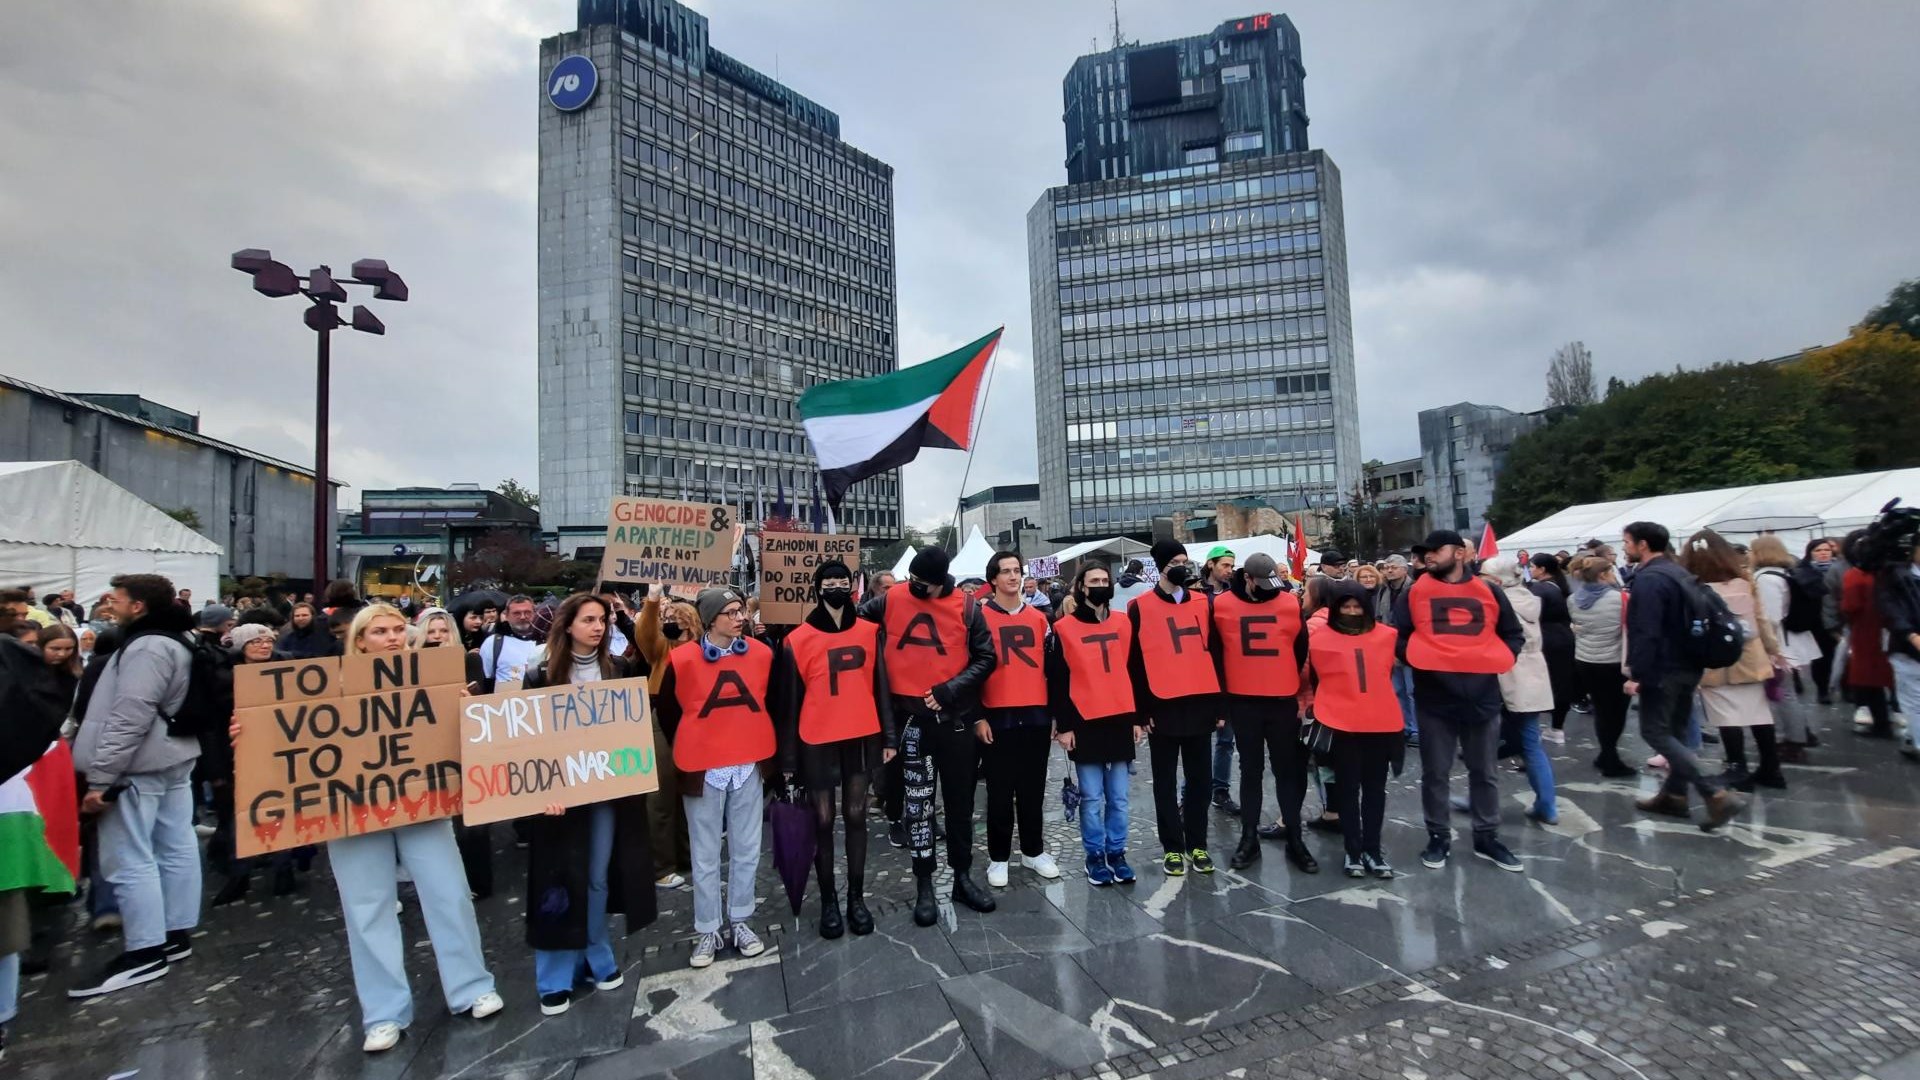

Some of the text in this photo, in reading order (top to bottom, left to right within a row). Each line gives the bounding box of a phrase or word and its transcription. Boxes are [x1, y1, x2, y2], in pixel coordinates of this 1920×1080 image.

[614, 502, 730, 532] GENOCIDE &
[614, 526, 715, 548] APARTHEID
[640, 546, 700, 561] ARE NOT
[766, 538, 855, 553] ZAHODNI BREG
[783, 554, 796, 567] IN
[615, 558, 729, 585] JEWISH VALUES
[765, 571, 784, 584] DO
[775, 586, 818, 603] PORA
[896, 612, 947, 656] A
[1166, 615, 1209, 654] H
[1240, 615, 1279, 656] E
[1429, 597, 1485, 636] D
[998, 624, 1039, 669] R
[1081, 632, 1119, 673] T
[259, 652, 419, 700] TO NI
[827, 645, 866, 696] P
[465, 685, 644, 742] SMRT FAŠIZMU
[698, 670, 761, 718] A
[273, 689, 437, 743] VOJNA
[273, 732, 416, 784] TO JE
[468, 747, 654, 804] SVOBODA NARODU
[249, 760, 462, 834] GENOCID
